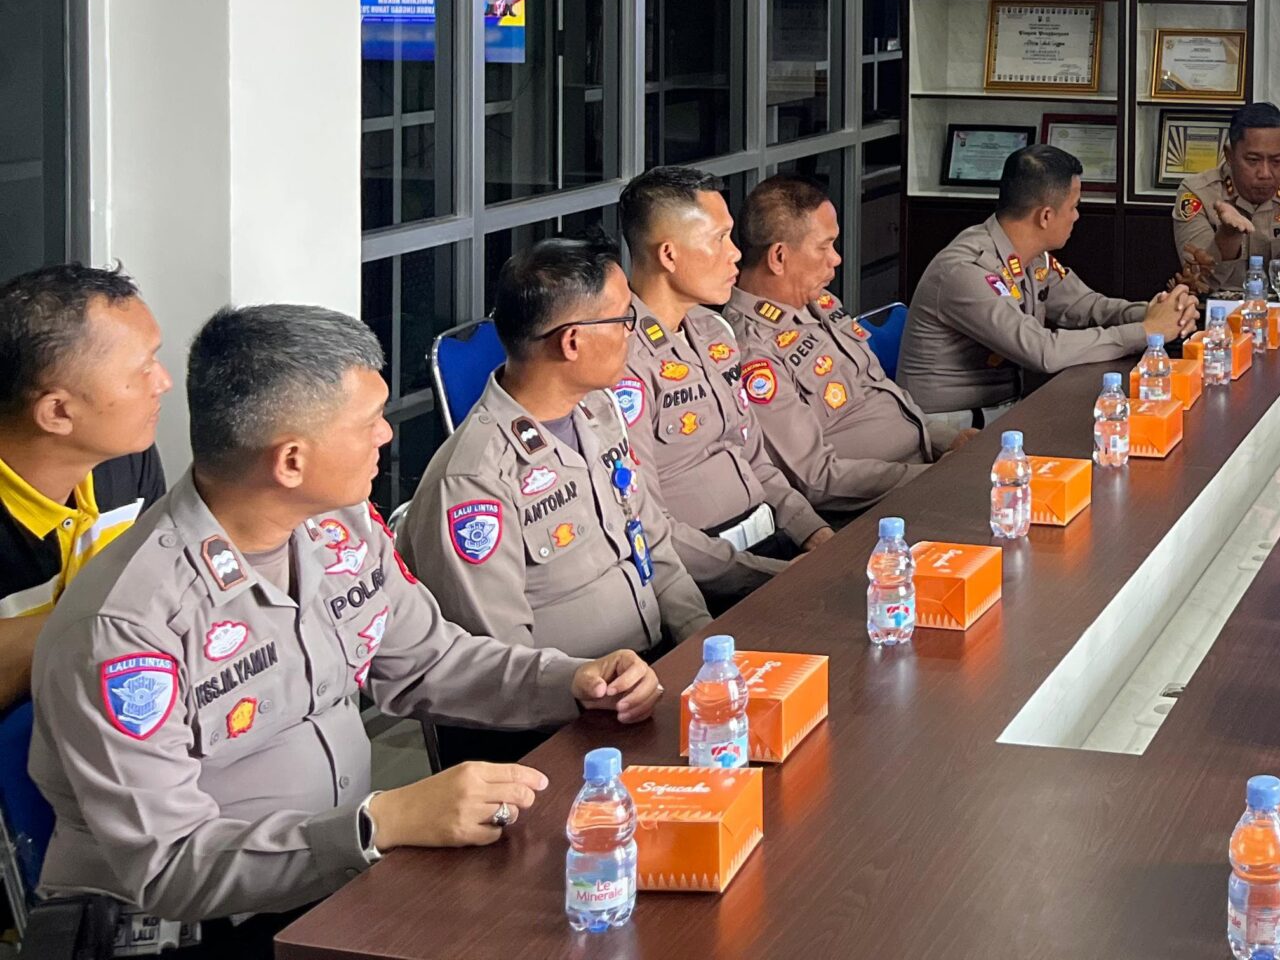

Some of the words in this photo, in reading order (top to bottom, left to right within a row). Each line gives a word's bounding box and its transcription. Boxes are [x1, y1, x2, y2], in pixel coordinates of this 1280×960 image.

[789, 333, 819, 367] DEDY
[453, 505, 472, 519] LALU
[474, 503, 499, 513] LINTAS
[109, 659, 136, 674] LALU
[139, 656, 173, 670] LINTAS
[576, 885, 624, 903] Minerale
[595, 879, 611, 893] Le
